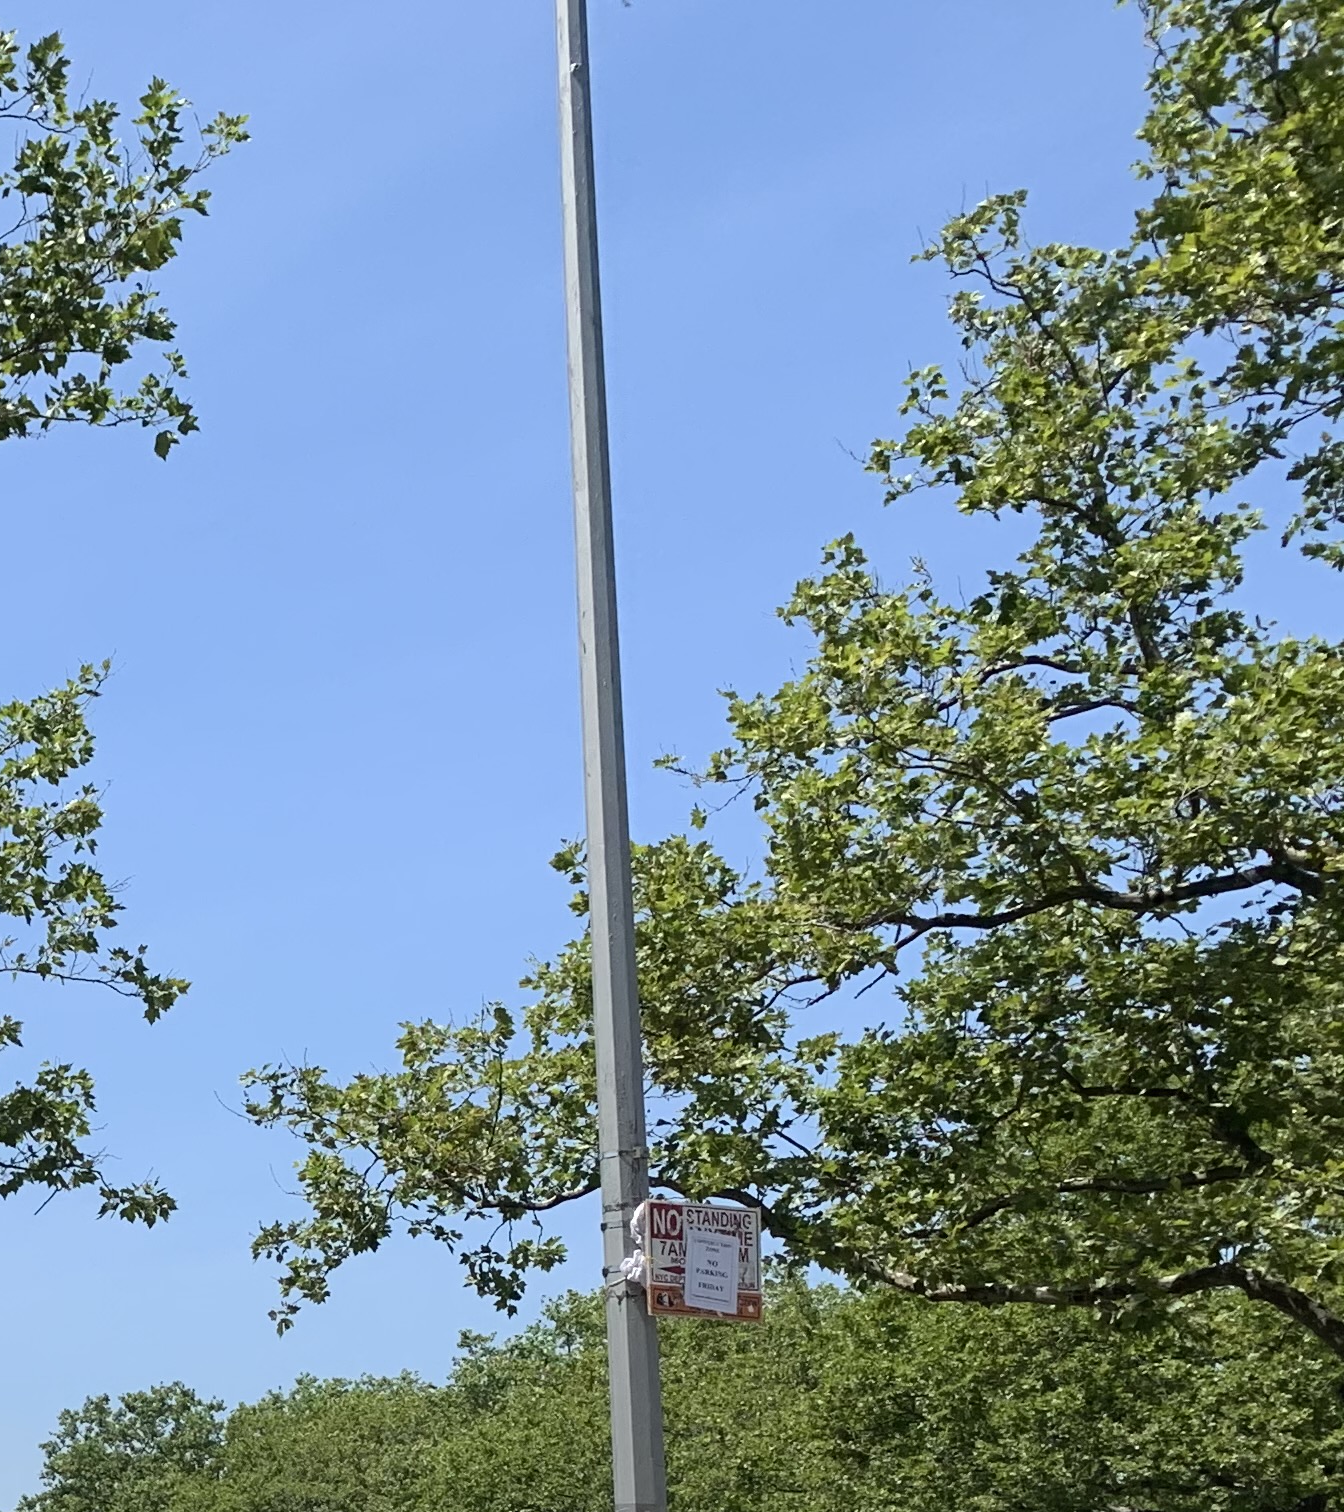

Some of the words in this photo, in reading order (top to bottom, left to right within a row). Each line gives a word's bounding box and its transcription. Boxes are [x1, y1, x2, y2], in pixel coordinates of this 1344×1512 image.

[653, 1208, 680, 1236] NO
[686, 1209, 752, 1229] STANDING
[707, 1259, 719, 1268] NO
[695, 1268, 729, 1279] PARKING
[698, 1281, 724, 1292] FRIDAY
